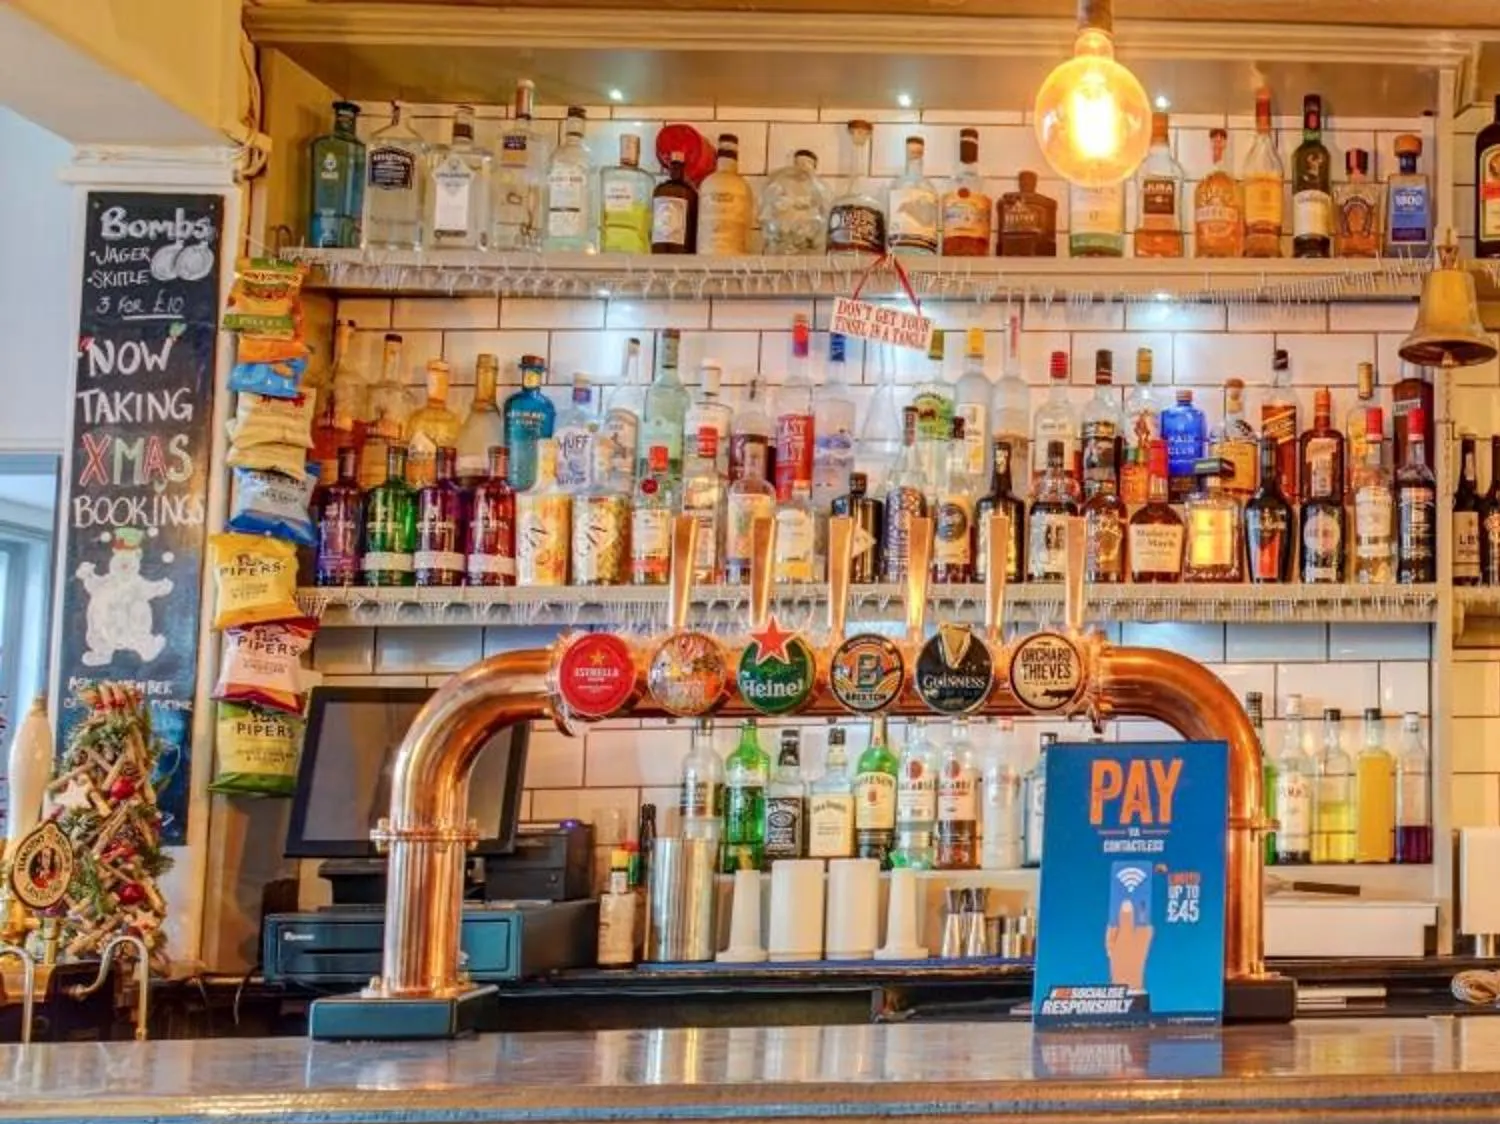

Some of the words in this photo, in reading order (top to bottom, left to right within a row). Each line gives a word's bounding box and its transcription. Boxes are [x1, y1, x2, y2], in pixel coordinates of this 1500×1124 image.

[100, 206, 212, 240] Bombs
[87, 337, 174, 377] NOW
[76, 387, 194, 424] TAKING
[80, 434, 192, 487] XMAS
[74, 495, 205, 528] BOOKINGS
[237, 635, 299, 657] PIPERS
[1022, 648, 1071, 664] ORCHARD
[923, 674, 986, 689] GUINNESS
[1022, 664, 1073, 681] THIEVES
[236, 721, 295, 739] PIPERS
[1089, 758, 1184, 825] PAY
[1103, 839, 1165, 853] CONTACTLESS
[1168, 885, 1183, 899] UP
[1187, 885, 1200, 899] TO
[1166, 900, 1200, 923] £45
[1042, 999, 1134, 1015] RESPONSIBLY
